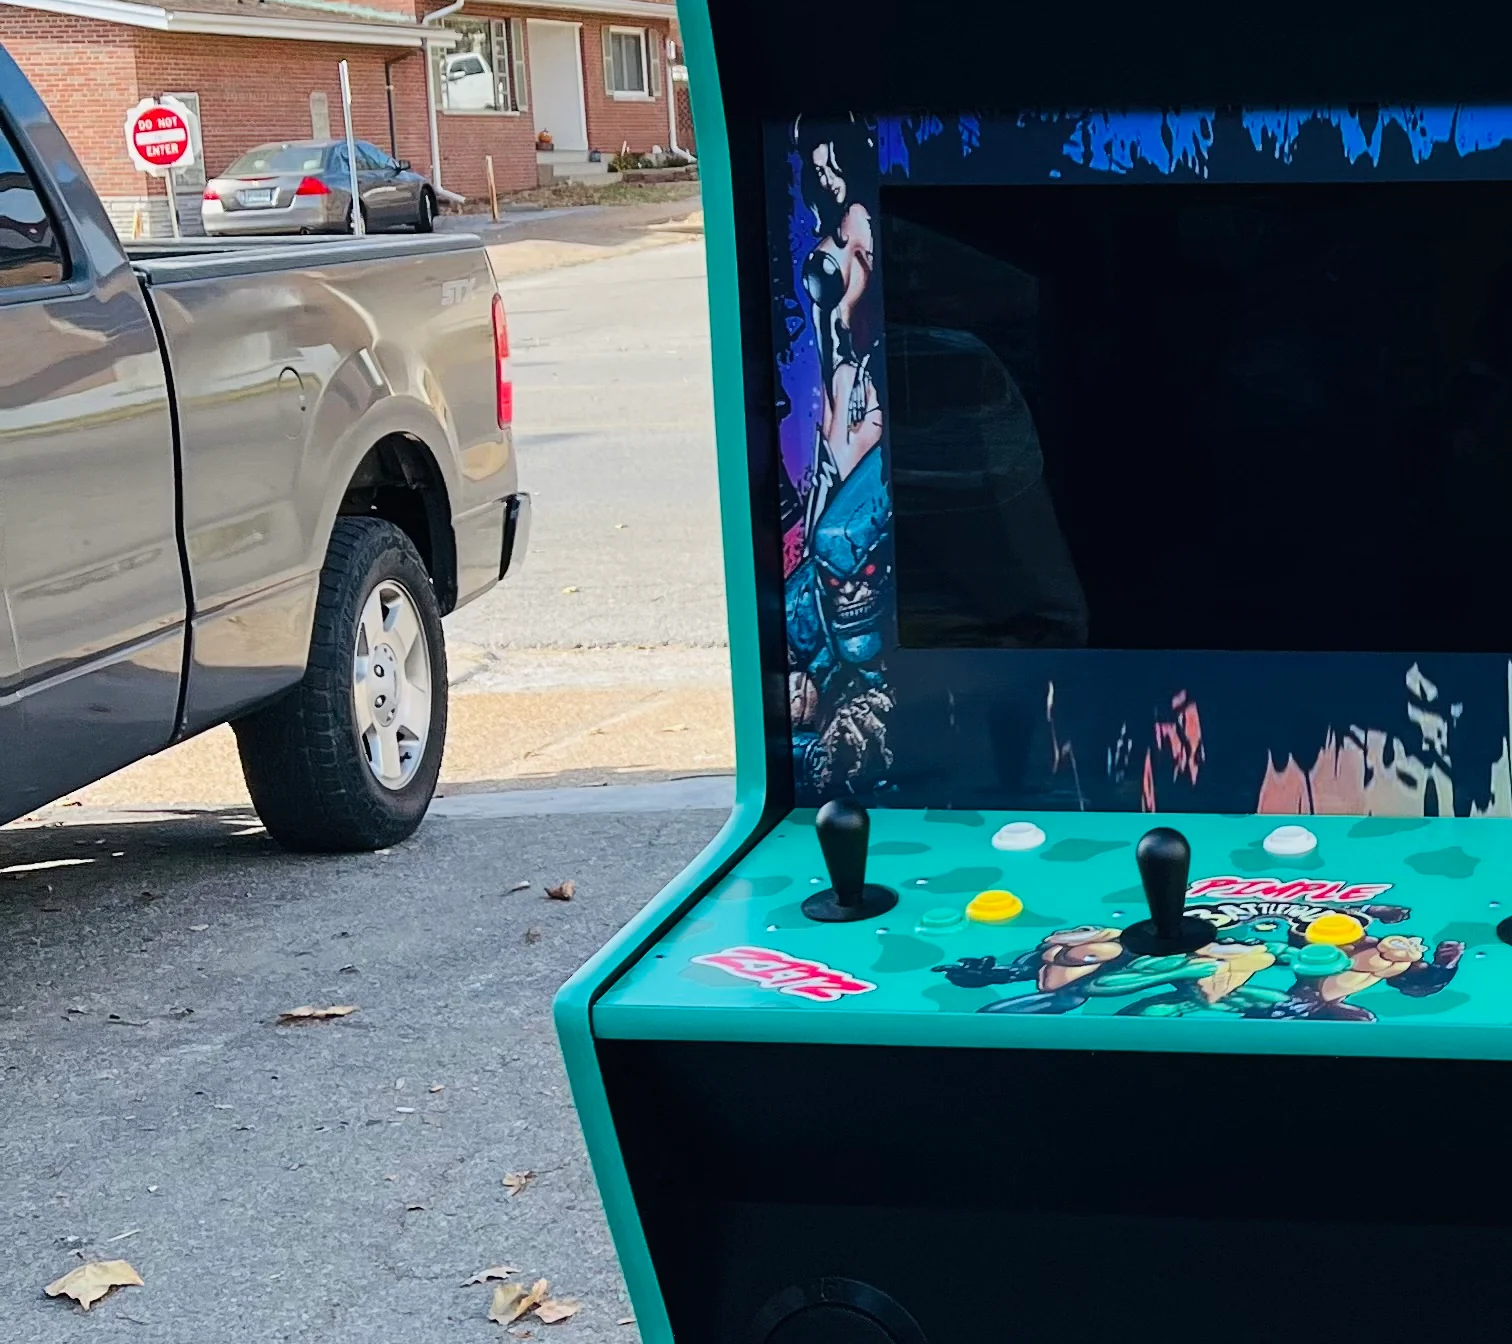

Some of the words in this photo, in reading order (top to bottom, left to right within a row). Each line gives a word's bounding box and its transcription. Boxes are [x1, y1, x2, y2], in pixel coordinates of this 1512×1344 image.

[138, 119, 153, 131] DO
[157, 116, 178, 129] NOT
[146, 143, 179, 158] ENTER
[1188, 878, 1389, 901] PIMPLE
